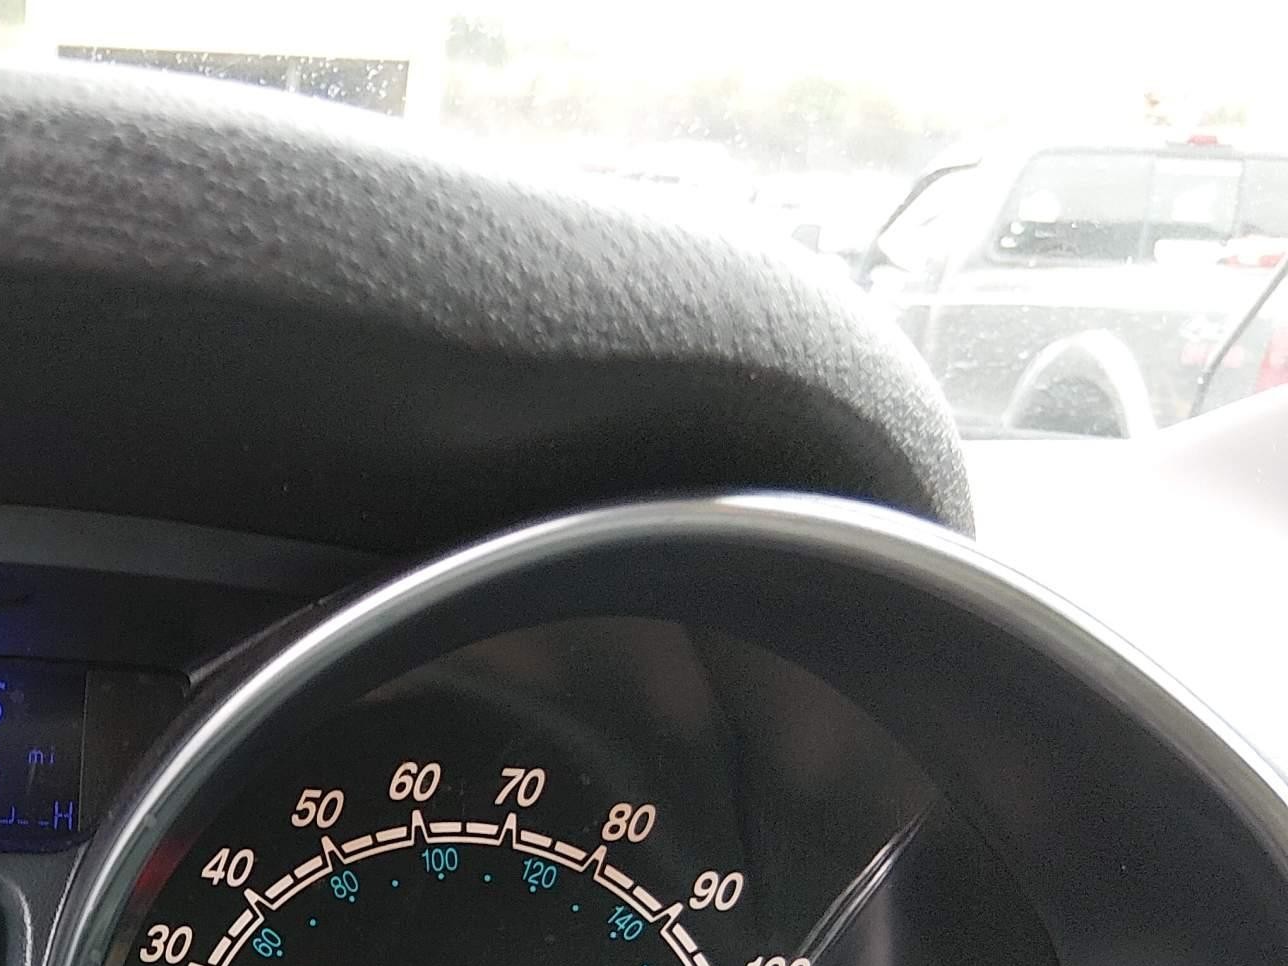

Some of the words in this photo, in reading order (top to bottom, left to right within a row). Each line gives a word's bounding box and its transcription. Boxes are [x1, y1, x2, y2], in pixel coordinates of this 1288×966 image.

[28, 746, 55, 764] mi
[388, 762, 441, 802] 60
[493, 768, 546, 806] 70
[291, 790, 344, 829] 50
[601, 804, 656, 842] 80
[201, 849, 254, 887] 40
[421, 848, 458, 872] 100
[521, 860, 557, 889] 120
[330, 871, 358, 898] 80
[689, 872, 743, 911] 90
[253, 928, 281, 956] 60
[607, 906, 643, 940] 140
[140, 925, 191, 964] 30
